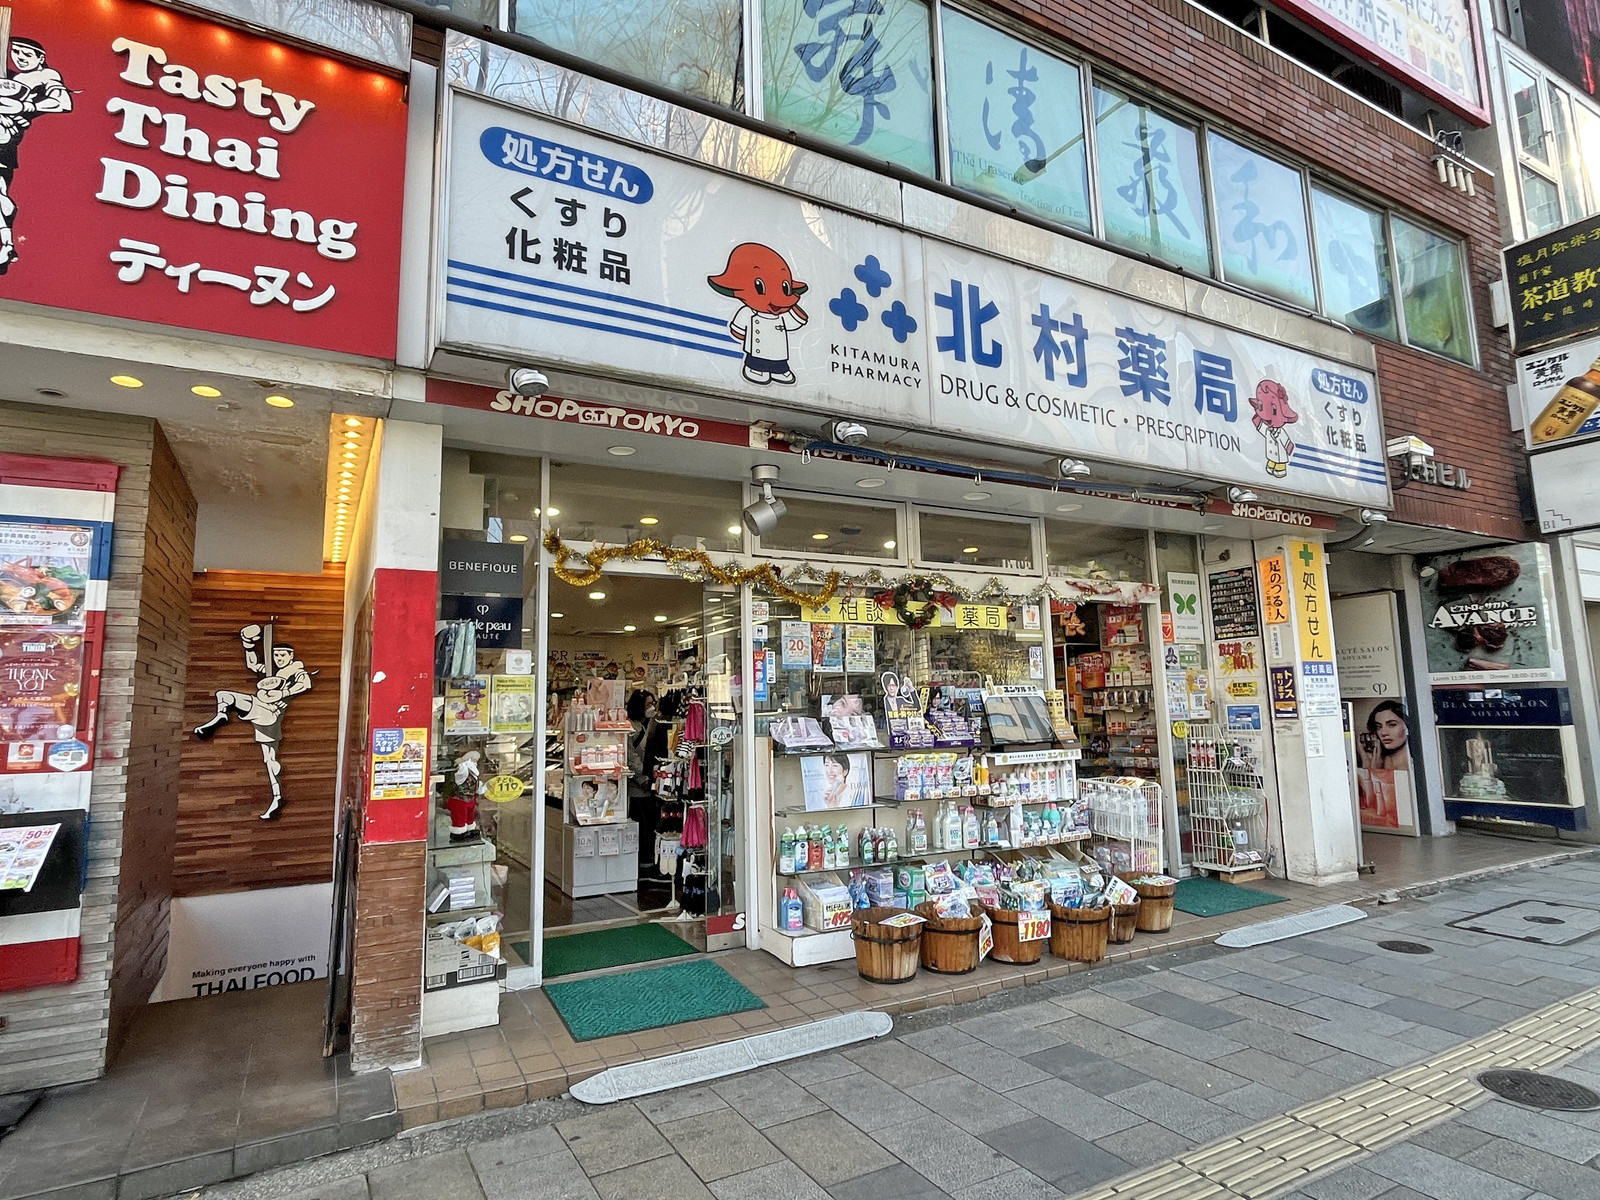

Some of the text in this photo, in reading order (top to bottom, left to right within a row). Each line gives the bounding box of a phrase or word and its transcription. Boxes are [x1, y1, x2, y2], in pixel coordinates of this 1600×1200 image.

[111, 36, 316, 134] Tasty
[106, 96, 281, 180] Thai
[500, 132, 641, 198] 処方せん
[95, 156, 358, 261] Dining
[509, 186, 628, 238] くすり
[504, 226, 632, 286] 化粧品
[109, 238, 336, 313] ティーヌン
[1518, 267, 1600, 311] 茶道教
[829, 342, 922, 372] KITAMURA
[933, 278, 1240, 424] 北村薬局
[830, 360, 923, 390] PHARMACY
[1317, 370, 1363, 401] 処方せん
[490, 390, 580, 421] SHOP
[606, 407, 699, 438] TOKYO
[939, 372, 1242, 454] DRUG & COSMETIC PRESCRIPTION
[1324, 401, 1362, 426] くすり
[1326, 425, 1367, 453] 化粧品
[1231, 503, 1312, 526] SHOP TOKYO
[449, 560, 518, 574] BENEFIQUE
[1268, 559, 1286, 621] 足のつる人
[486, 620, 512, 637] peau
[962, 606, 1001, 628] 薬局
[1302, 571, 1323, 659] 処方せん
[1428, 605, 1537, 629] AVANCE
[476, 632, 500, 640] AUTÉ
[1337, 645, 1390, 655] AUTÉ SALON
[1284, 670, 1295, 699] トノス
[192, 954, 316, 979] Making everyone happy with
[192, 967, 315, 997] THAI FOOD
